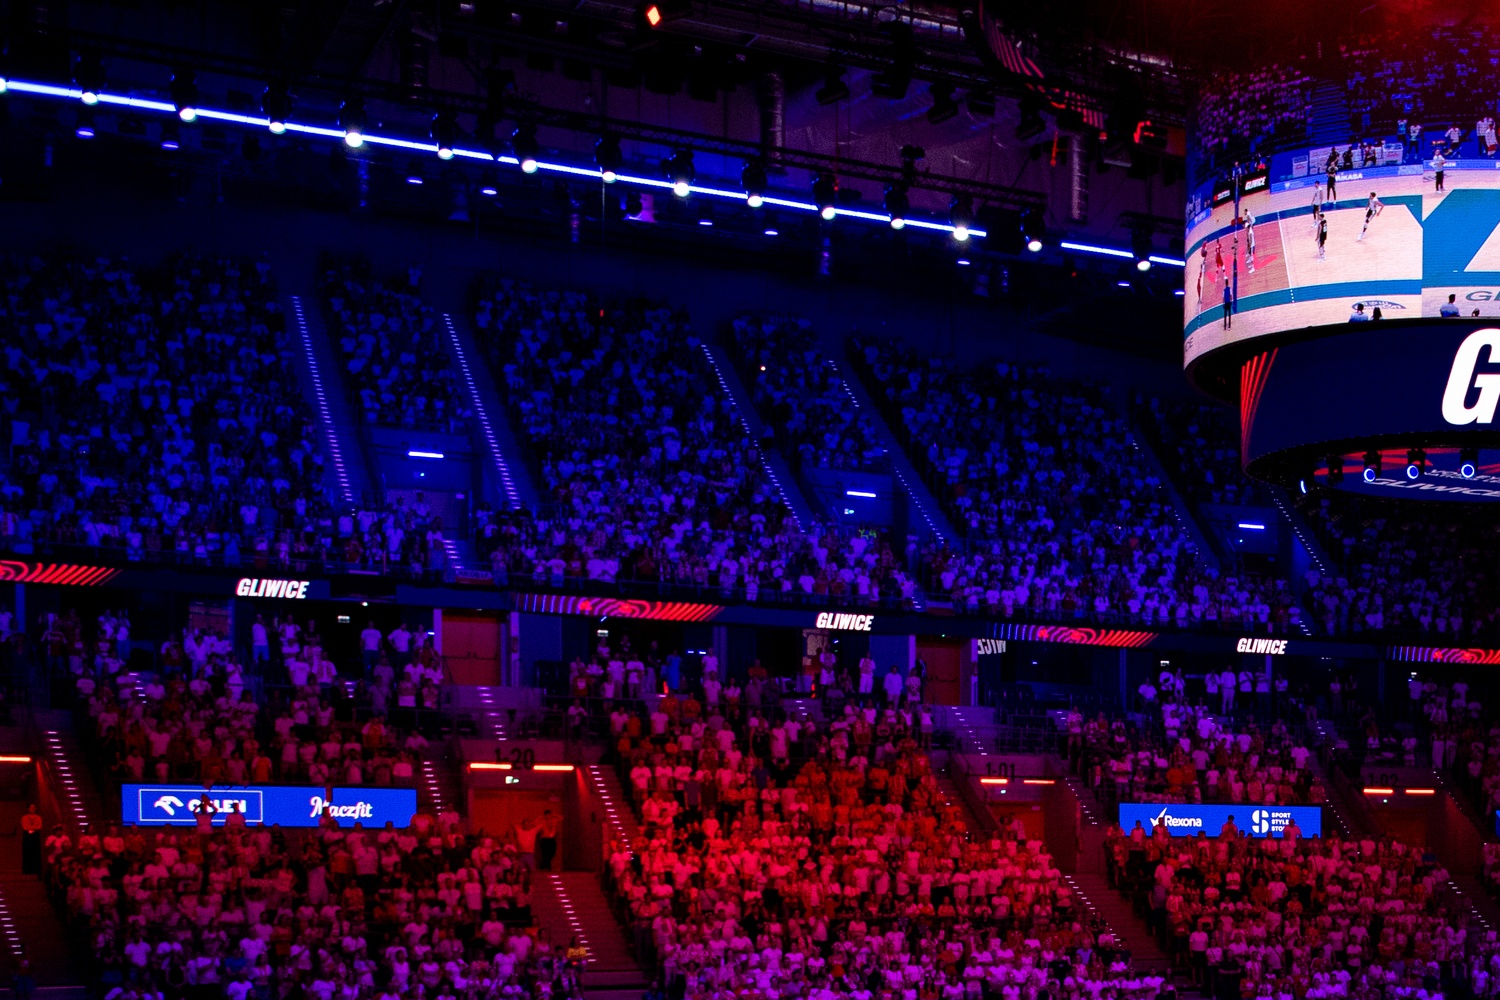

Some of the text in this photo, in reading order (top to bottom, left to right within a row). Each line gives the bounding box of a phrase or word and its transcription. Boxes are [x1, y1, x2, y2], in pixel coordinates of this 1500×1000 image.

[236, 578, 309, 599] GLIWICE
[816, 611, 874, 632] GLIWICE
[1236, 637, 1288, 655] GLIWICE
[1164, 814, 1202, 827] Rexona
